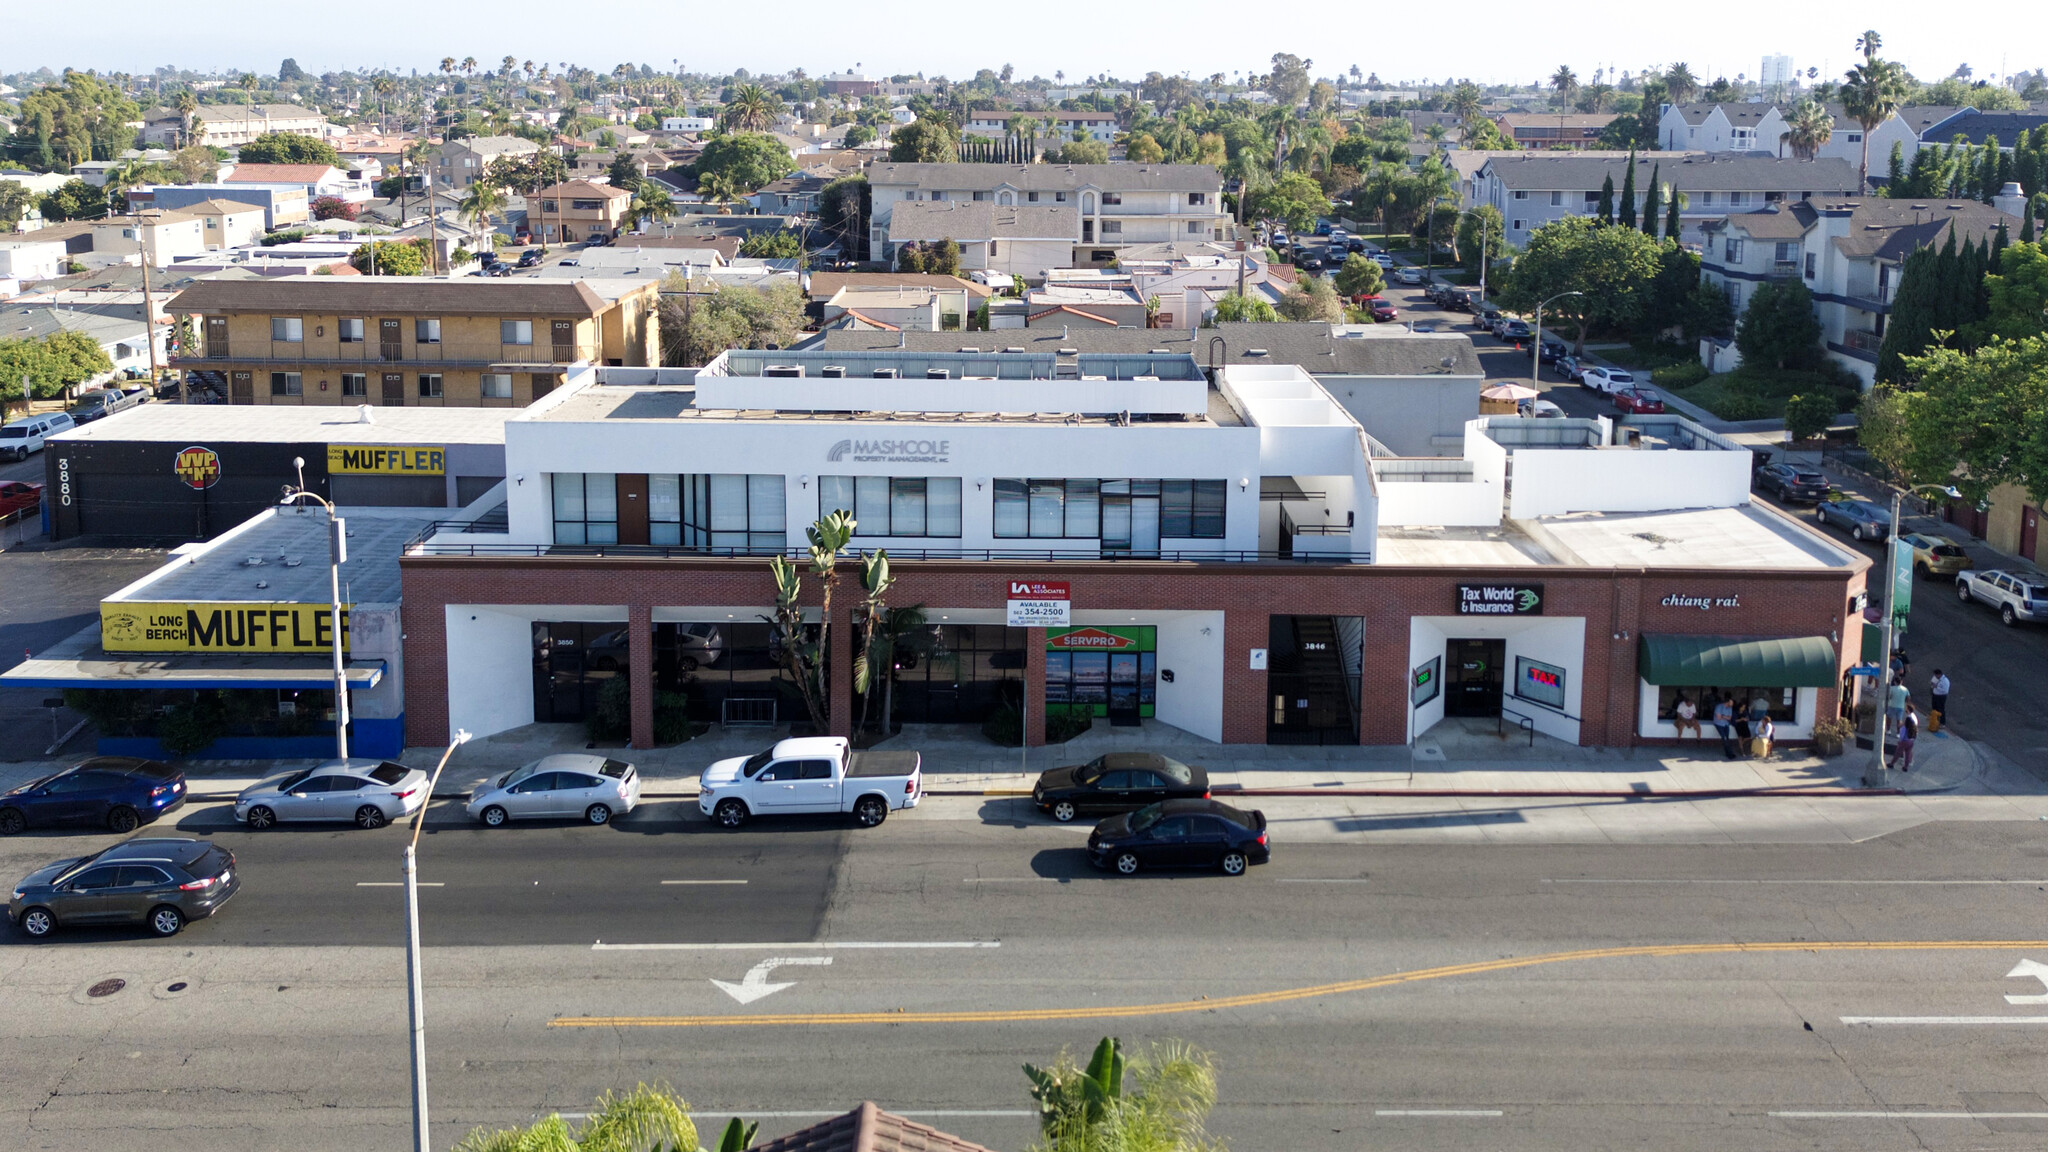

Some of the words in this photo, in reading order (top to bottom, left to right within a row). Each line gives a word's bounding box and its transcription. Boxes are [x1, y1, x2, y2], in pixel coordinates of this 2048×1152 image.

[854, 440, 949, 454] MASHCOLE
[179, 453, 216, 468] VVP
[343, 450, 442, 470] MUFFLER
[59, 458, 71, 506] 3880
[1461, 587, 1481, 600] Tax
[1484, 587, 1514, 600] World
[1461, 602, 1468, 613] &
[1470, 602, 1514, 613] Insurance
[1662, 593, 1711, 610] chiang
[1025, 608, 1064, 616] 354-2500
[150, 615, 183, 627] LONG
[146, 629, 188, 640] BEACH
[1530, 668, 1557, 686] TAX
